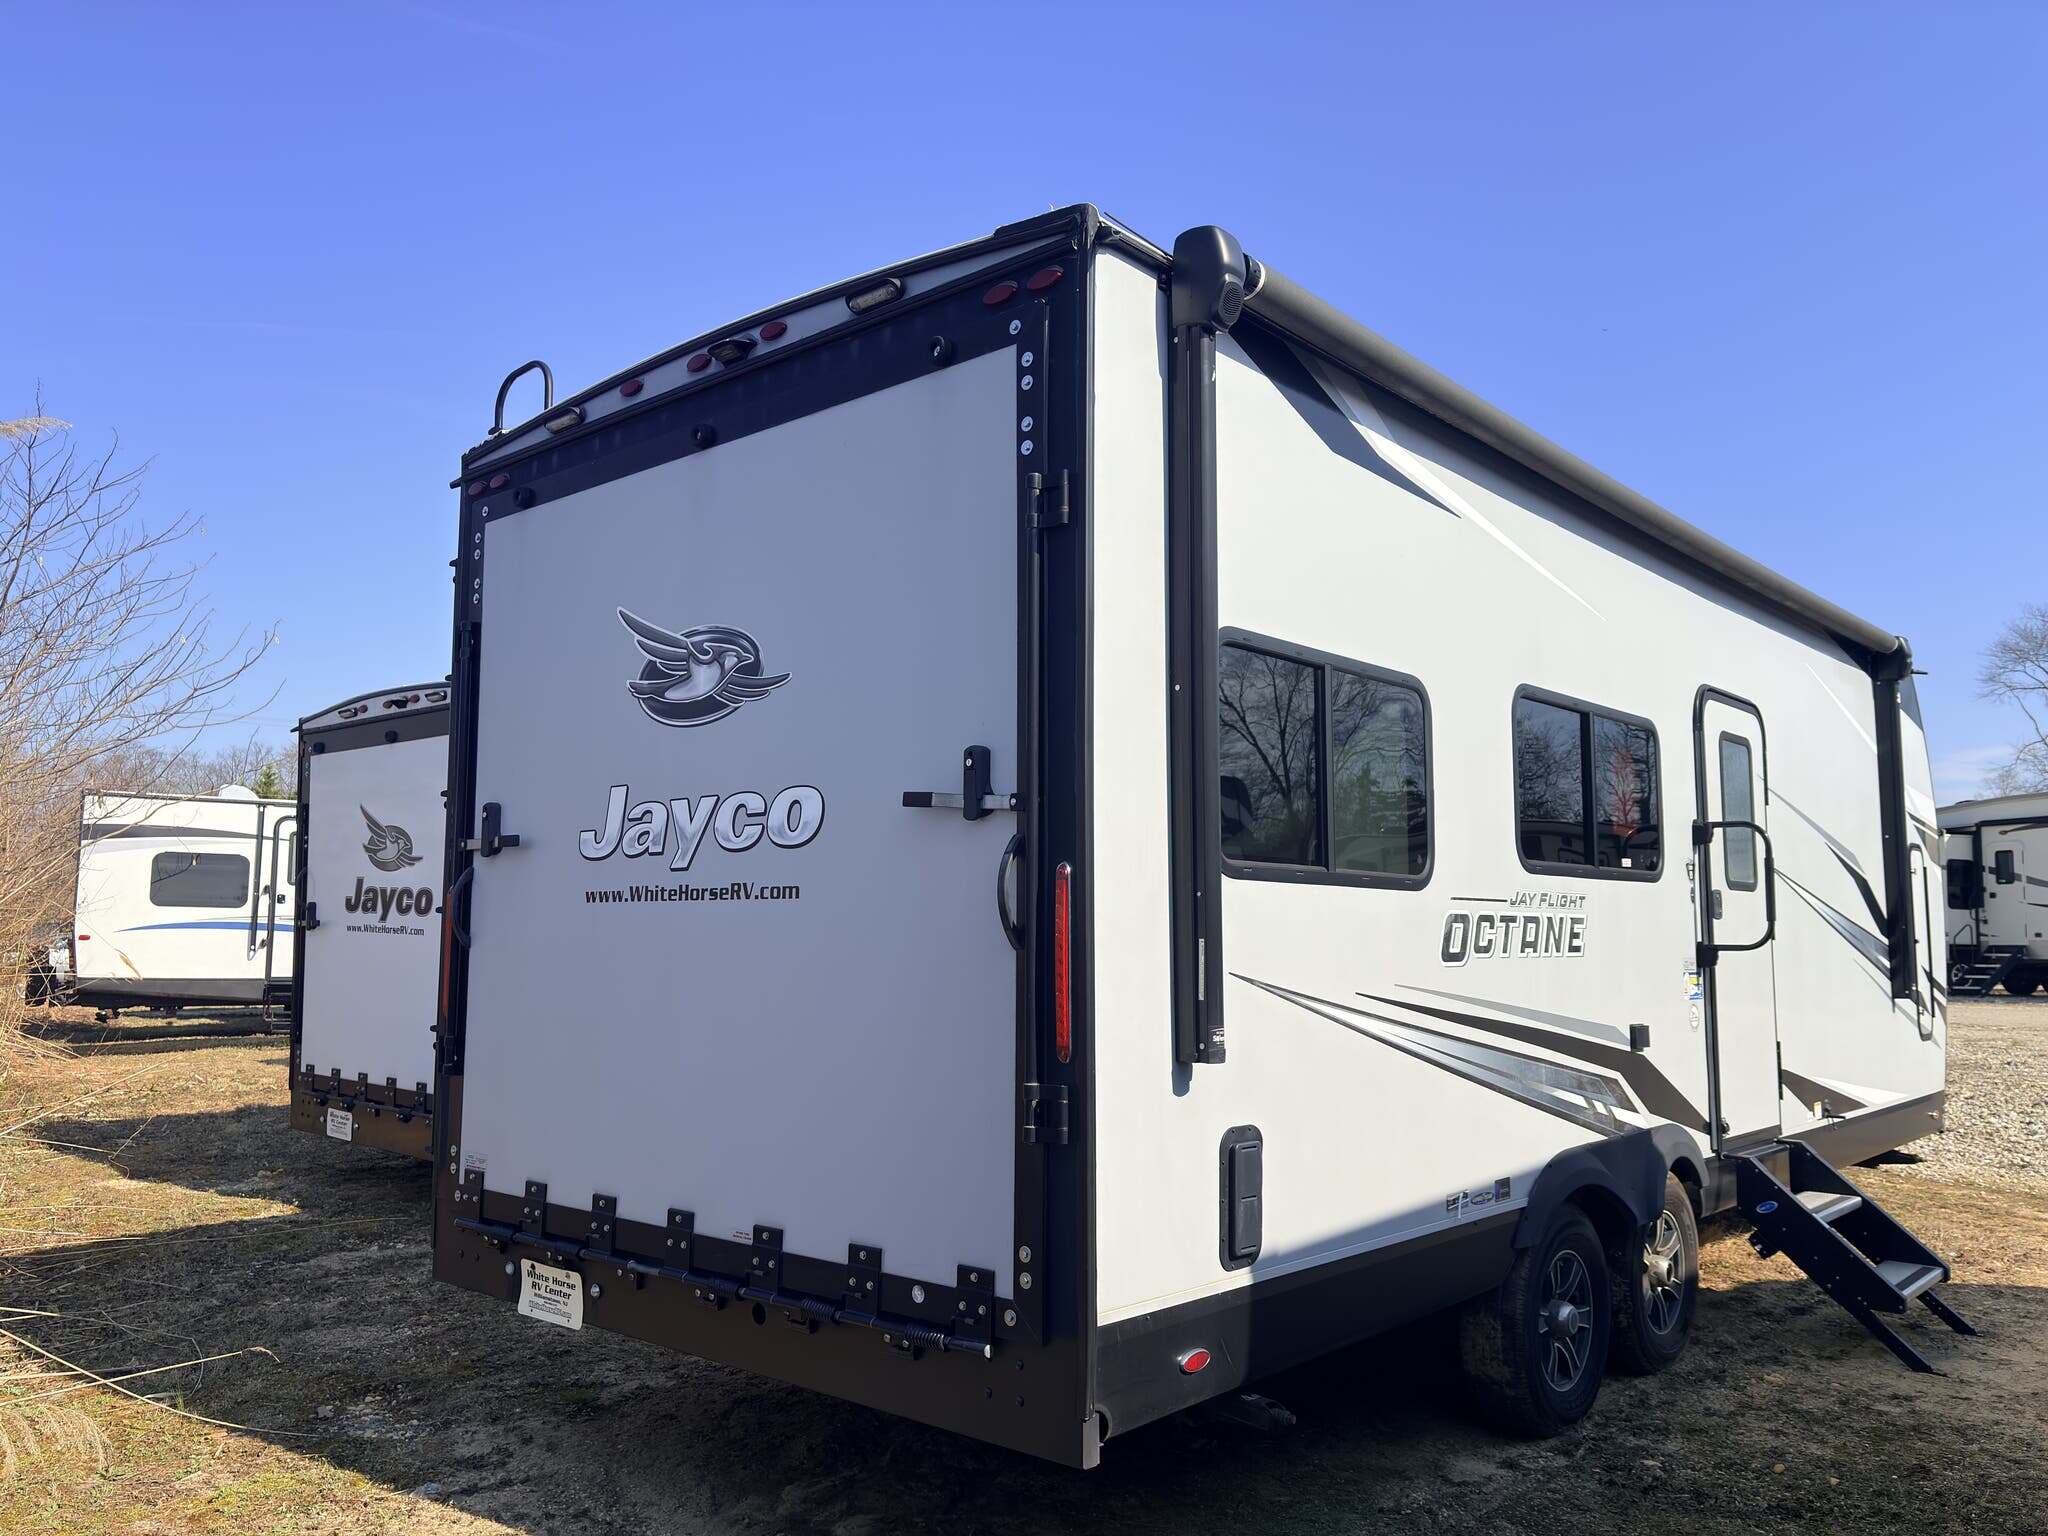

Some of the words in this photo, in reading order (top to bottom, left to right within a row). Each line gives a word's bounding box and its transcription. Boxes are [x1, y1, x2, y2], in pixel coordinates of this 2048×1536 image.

[579, 784, 825, 871] Jayco
[345, 876, 433, 923] Jayco
[585, 882, 800, 903] www.WhiteHorseRV.com
[1510, 891, 1537, 906] JAY
[1539, 892, 1586, 908] FLIGHT
[346, 924, 425, 936] www.WhiteHorseRV.com
[1440, 912, 1587, 966] OCTANE
[527, 1269, 550, 1283] White
[552, 1276, 577, 1291] Horse
[531, 1281, 543, 1292] RV
[545, 1285, 572, 1300] Center
